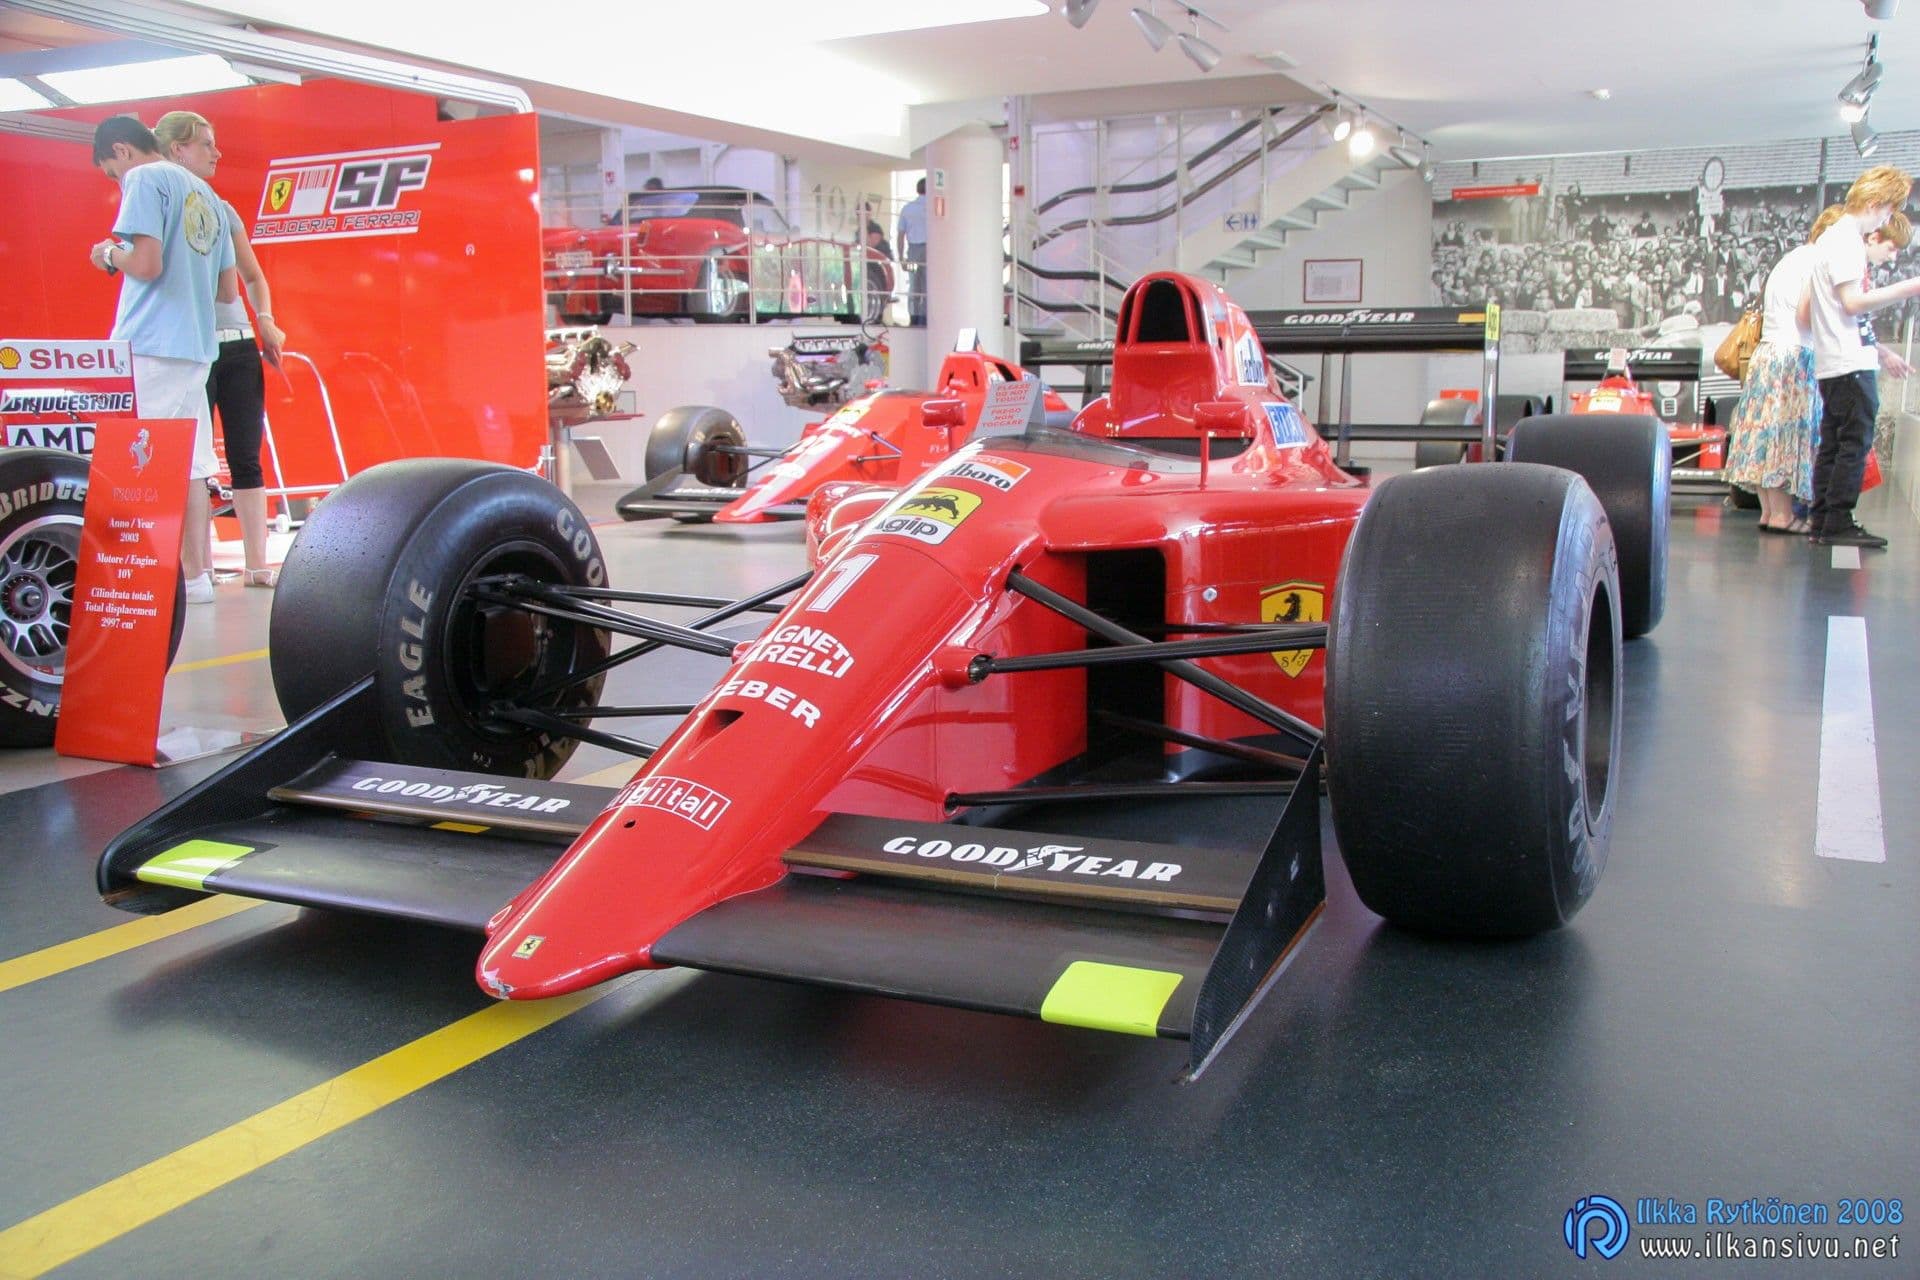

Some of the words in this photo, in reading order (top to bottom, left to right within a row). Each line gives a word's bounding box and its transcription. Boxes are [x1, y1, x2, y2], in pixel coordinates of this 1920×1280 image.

[331, 155, 431, 213] SF
[254, 217, 336, 236] SCUDERIA
[343, 210, 421, 231] FERRARI
[1283, 309, 1414, 325] GOODYEAR
[29, 348, 116, 370] Shell
[2, 393, 132, 413] BRIDGESTONE
[947, 463, 1011, 490] lboro
[109, 517, 129, 529] Anno
[137, 518, 155, 530] Year
[120, 532, 139, 543] 2003
[96, 552, 124, 564] Motore
[130, 555, 158, 569] Engine
[117, 569, 133, 579] 10V
[806, 554, 879, 613] 1
[91, 587, 130, 600] Cilindrata
[131, 589, 154, 601] totale
[84, 601, 104, 612] Total
[105, 602, 157, 617] displacement
[100, 618, 120, 629] 2997
[401, 579, 435, 727] EAGLE
[351, 777, 571, 813] GOODYEAR
[882, 835, 1183, 882] GOODYEAR
